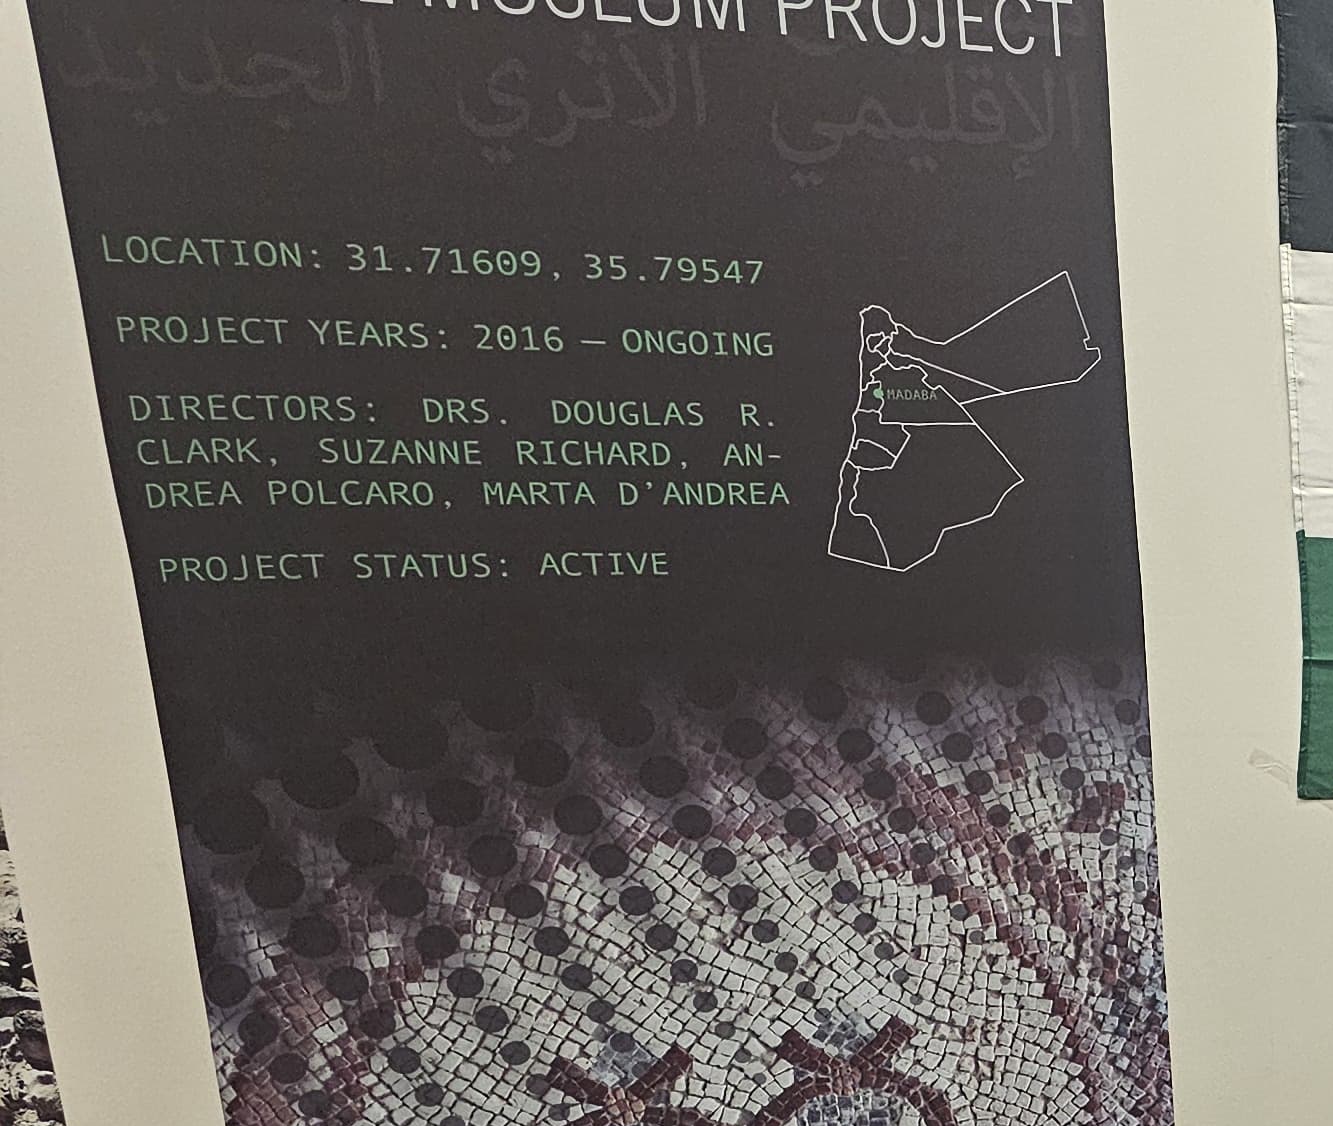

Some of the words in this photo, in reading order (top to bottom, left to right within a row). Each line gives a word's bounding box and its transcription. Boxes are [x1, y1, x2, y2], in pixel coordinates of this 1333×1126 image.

[102, 235, 320, 268] LOCATION:
[347, 244, 559, 280] 31.71609,
[585, 254, 763, 283] 35.79547
[117, 317, 288, 344] PROJECT
[308, 320, 446, 348] YEARS:
[474, 325, 563, 351] 2016
[623, 329, 773, 356] ONGOING
[887, 389, 938, 400] MADABA
[129, 395, 375, 422] DIRECTORS:
[423, 399, 506, 424] DRS.
[552, 400, 703, 426] DOUGLAS
[741, 404, 773, 426] R.
[138, 438, 276, 466] CLARK,
[320, 438, 481, 464] SUZANNE
[517, 441, 686, 469] RICHARD,
[724, 444, 780, 466] AN-
[146, 481, 242, 508] DREA
[268, 480, 451, 509] POLCARO,
[483, 482, 595, 505] MARTA
[160, 554, 324, 582] PROJECT
[354, 553, 507, 578] STATUS:
[540, 553, 668, 576] ACTIVE
